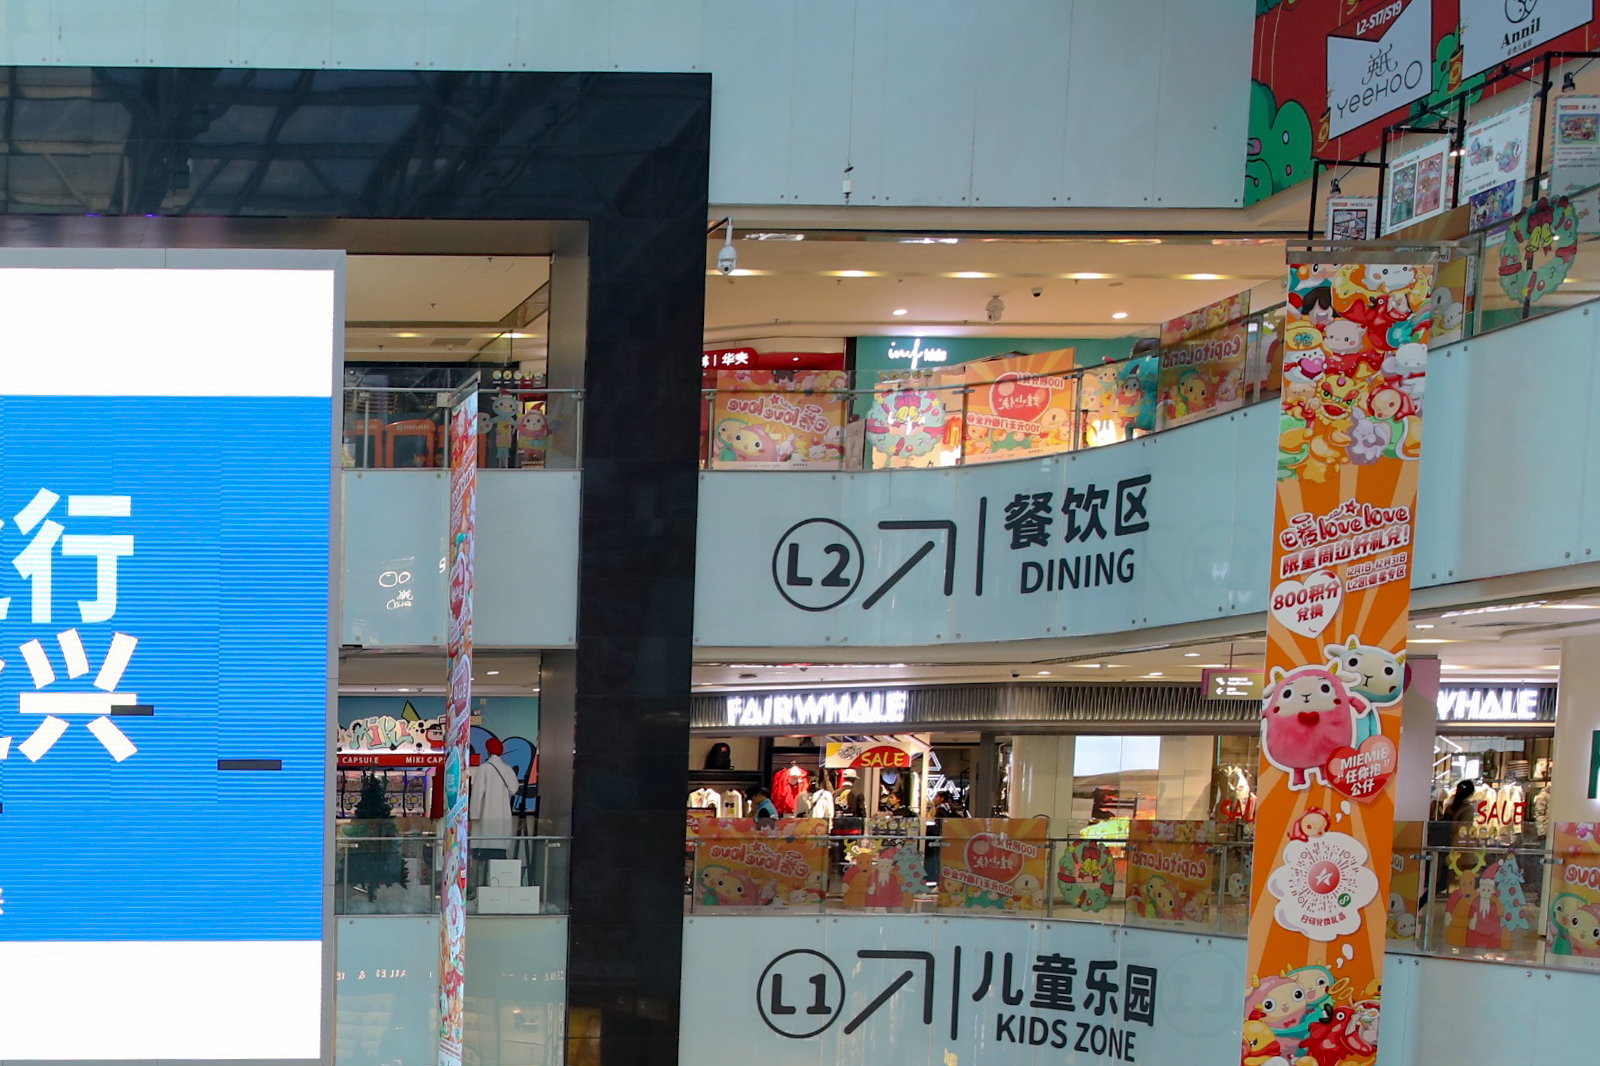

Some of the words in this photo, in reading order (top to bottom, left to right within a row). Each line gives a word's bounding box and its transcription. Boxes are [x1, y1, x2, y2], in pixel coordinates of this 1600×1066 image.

[1501, 17, 1540, 49] Annil
[1003, 473, 1152, 551] 餐饮区
[786, 542, 851, 588] L2
[1019, 547, 1136, 595] DINING
[1273, 579, 1341, 611] 800积分
[726, 690, 908, 726] FAIRWHALE
[342, 756, 379, 765] CAPSULE
[406, 756, 424, 764] MIKI
[861, 752, 905, 767] SALE
[1340, 747, 1388, 771] MIEMIE
[1351, 779, 1375, 797] 公仔
[771, 973, 832, 1015] L1
[972, 950, 1158, 1027] 儿童乐园
[996, 1013, 1068, 1050] KIDS
[1073, 1021, 1137, 1063] ZONE
